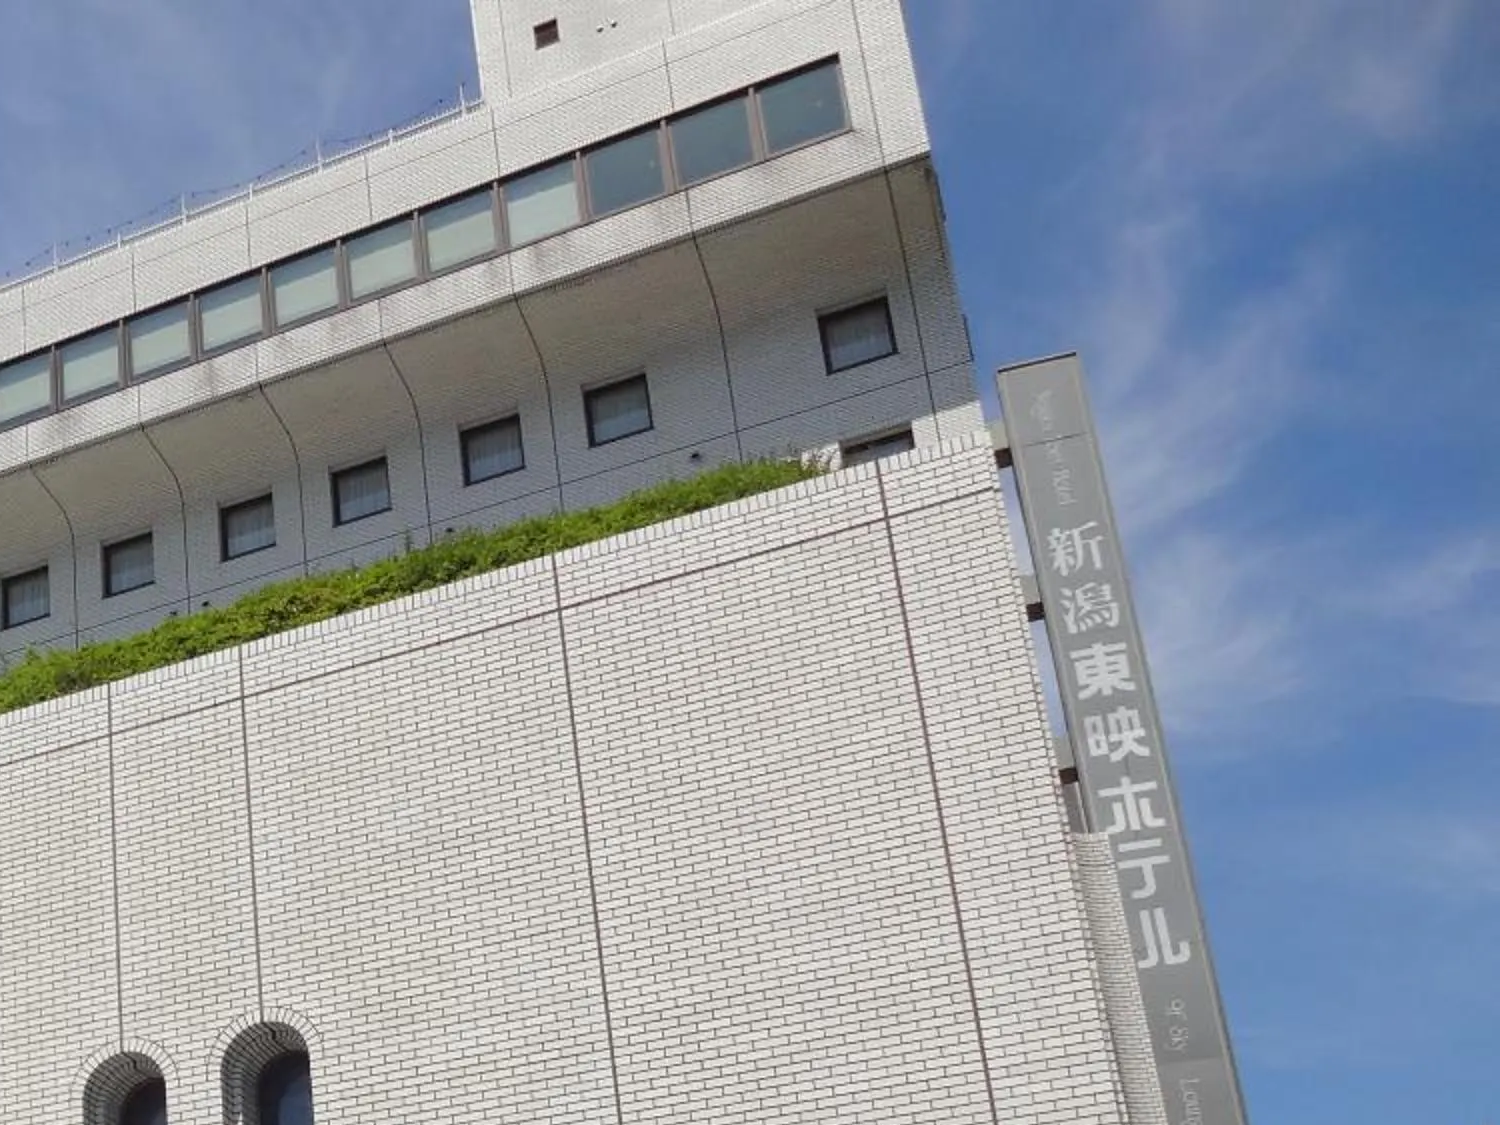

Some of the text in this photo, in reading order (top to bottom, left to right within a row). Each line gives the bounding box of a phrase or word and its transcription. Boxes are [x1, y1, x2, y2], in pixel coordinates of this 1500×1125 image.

[1046, 519, 1191, 970] 新潟東映ホテル
